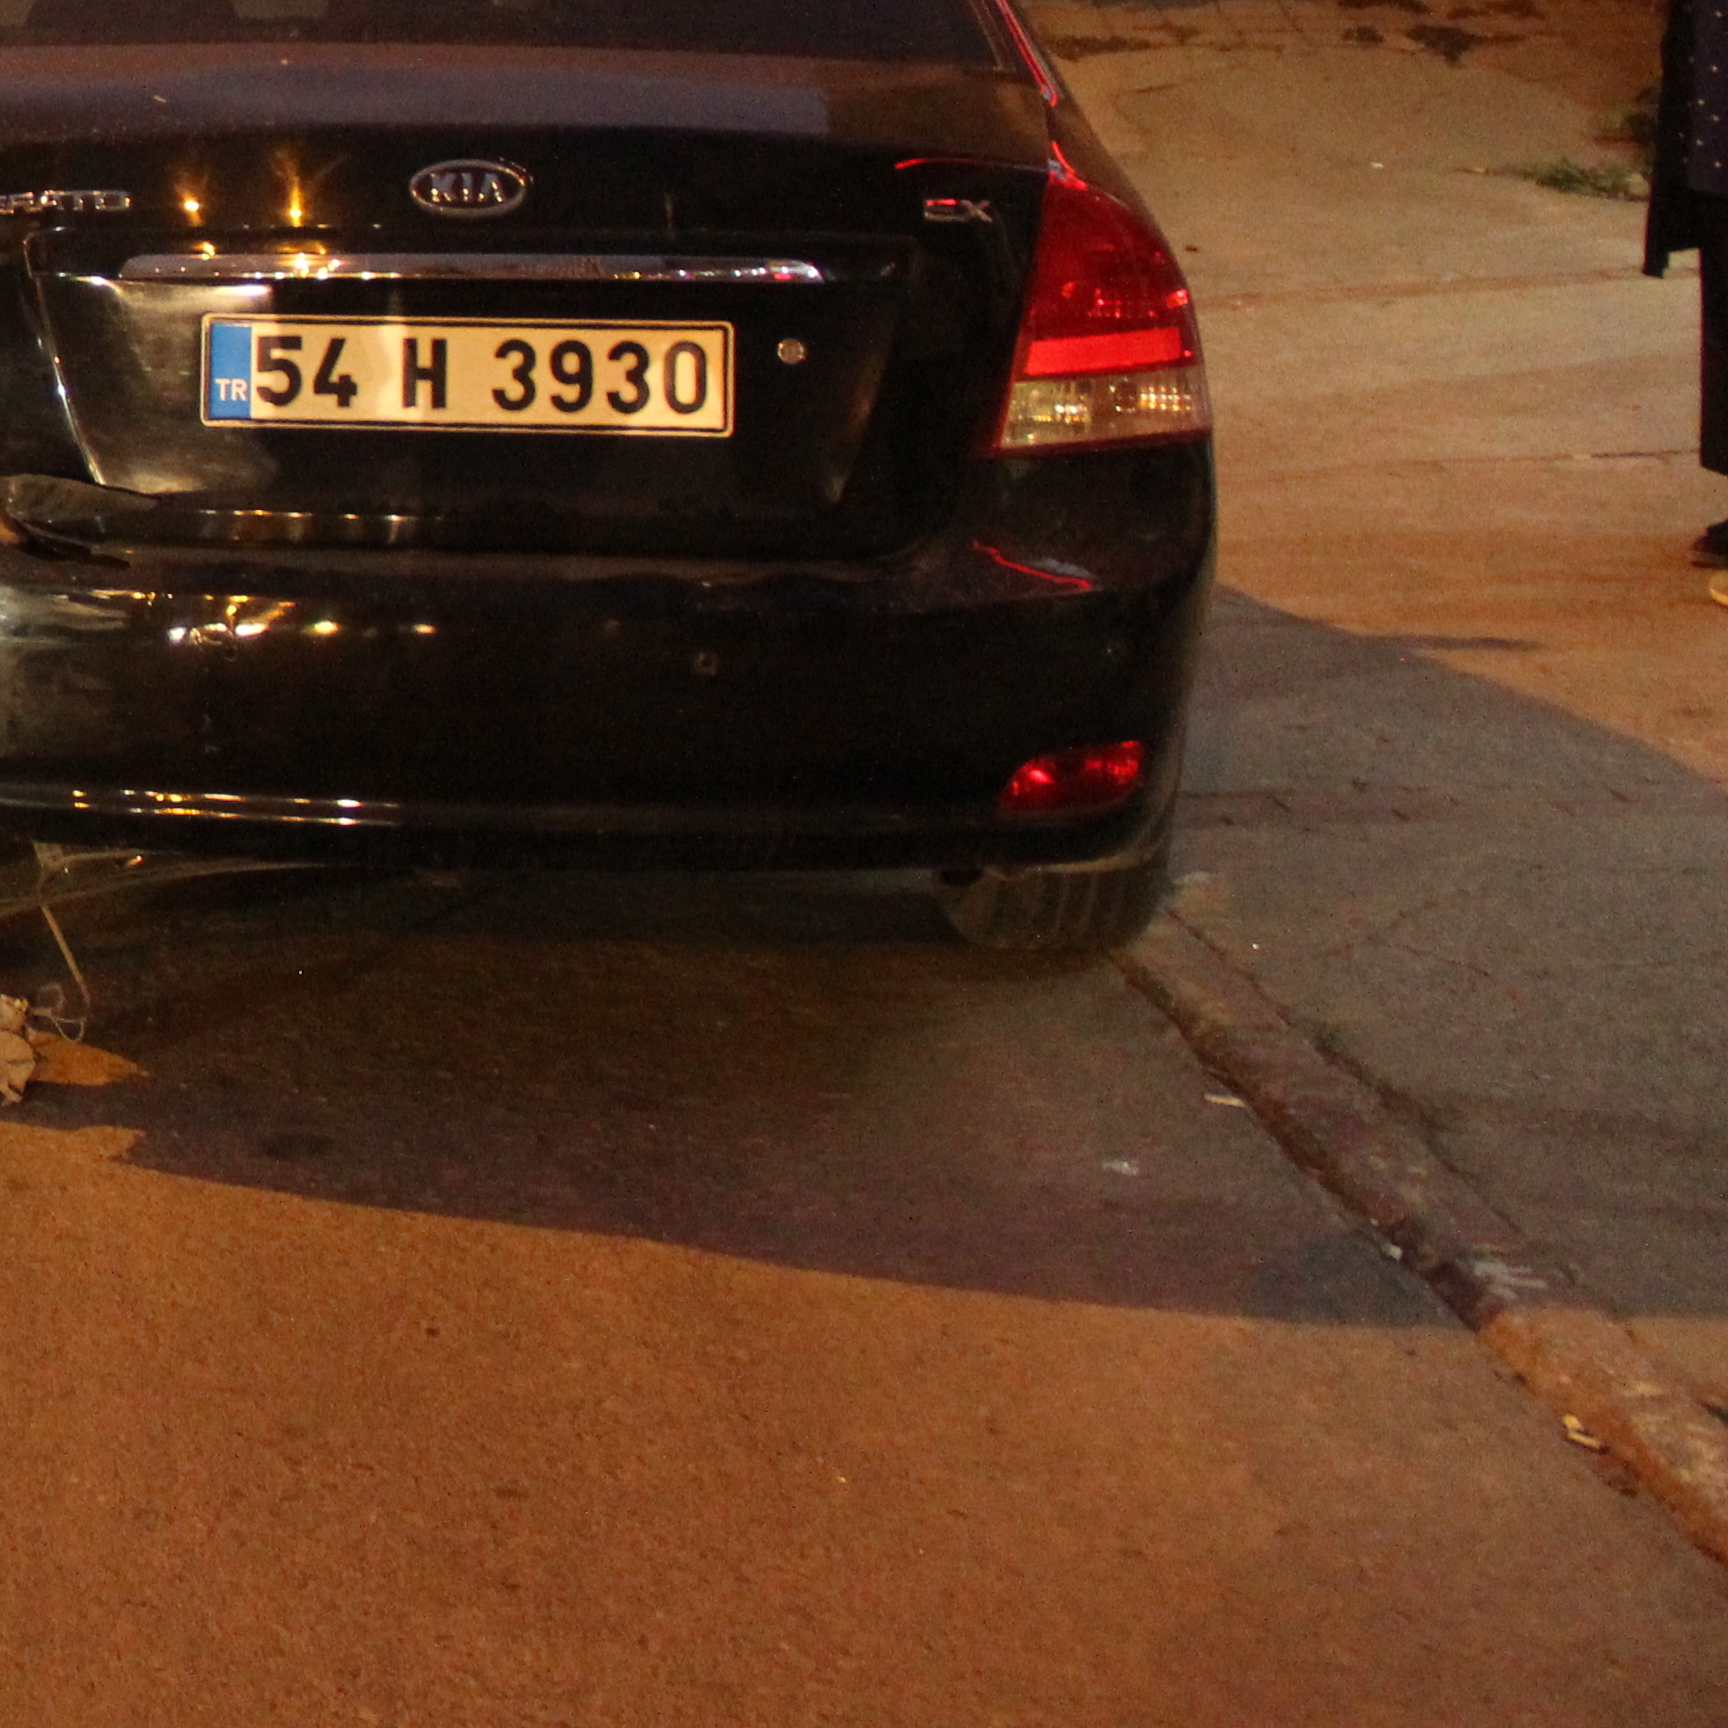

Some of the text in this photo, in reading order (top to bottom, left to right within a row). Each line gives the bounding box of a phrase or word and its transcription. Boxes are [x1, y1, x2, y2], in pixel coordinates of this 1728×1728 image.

[429, 172, 506, 204] KIA
[924, 197, 993, 223] EX
[215, 335, 709, 415] TR 54 H 3930
